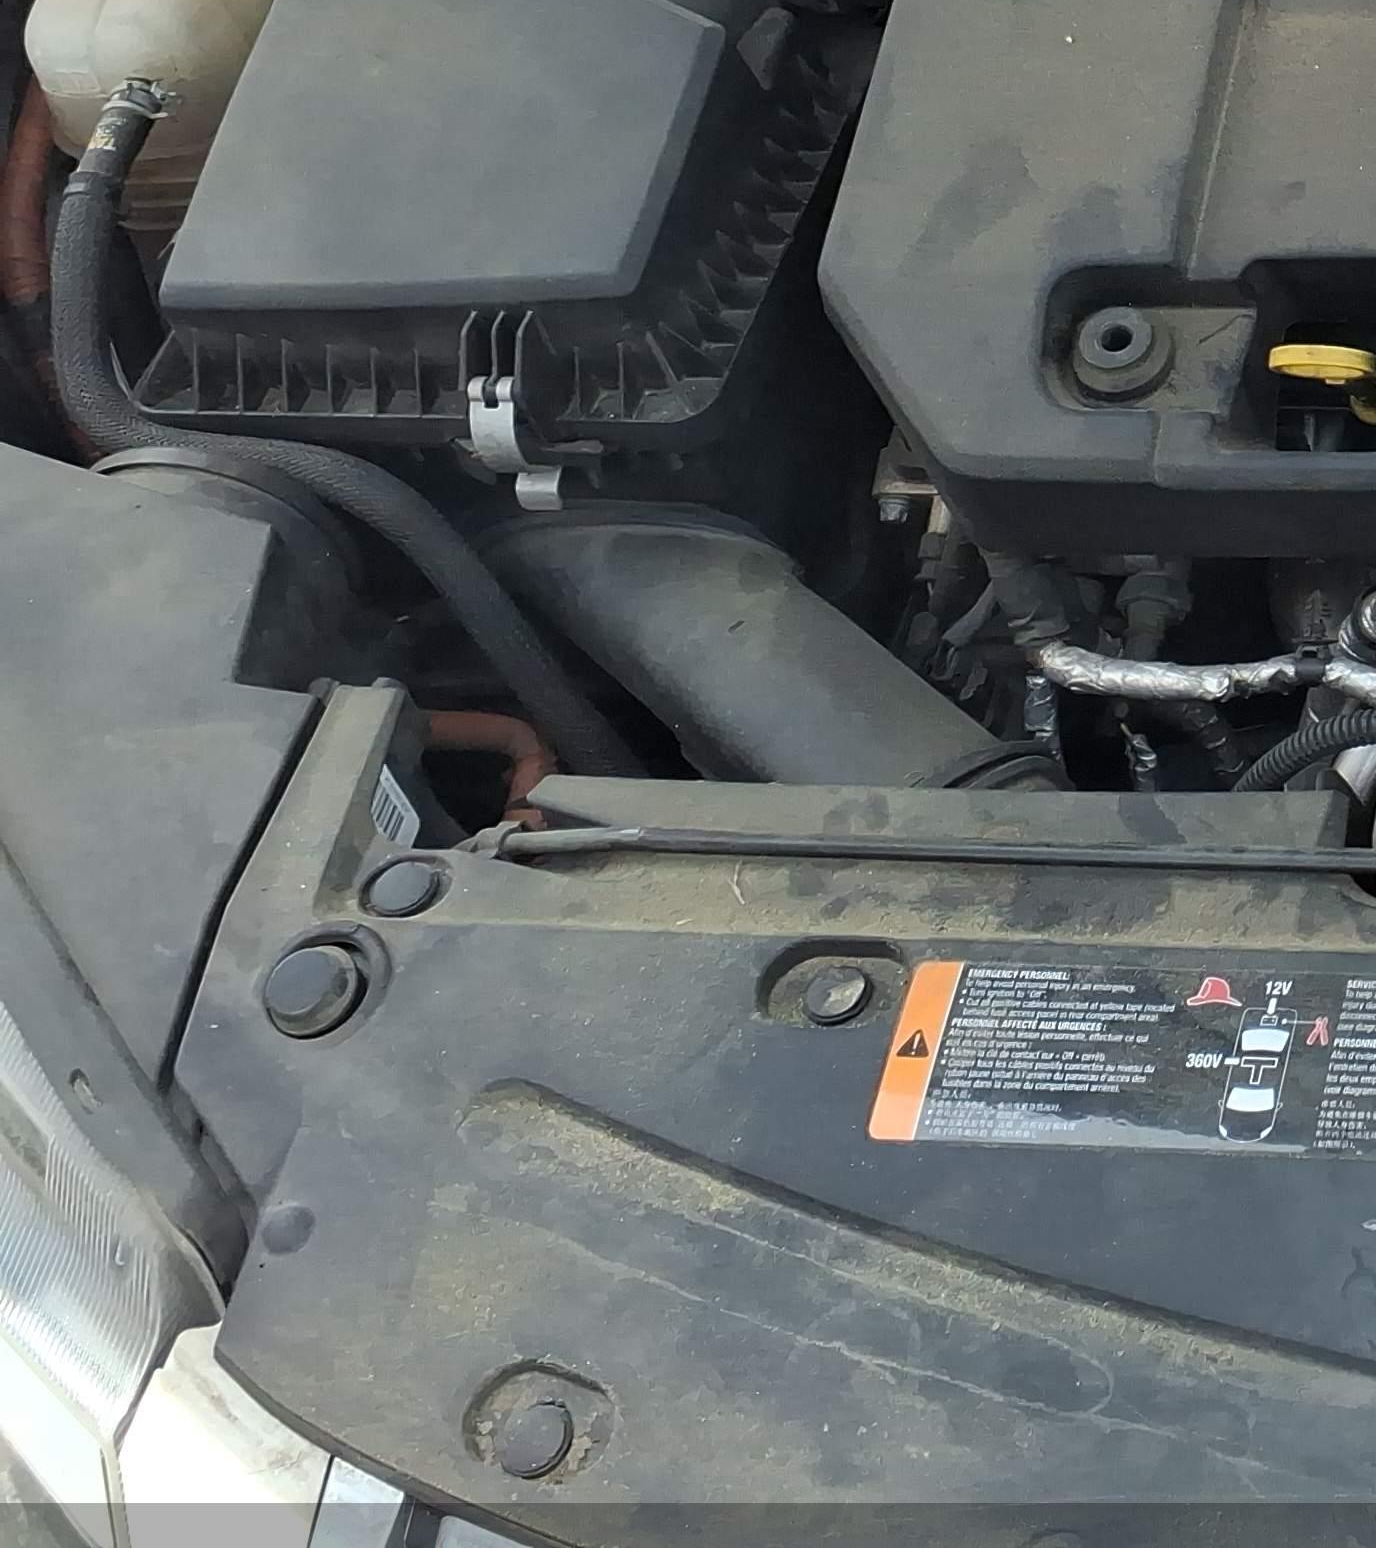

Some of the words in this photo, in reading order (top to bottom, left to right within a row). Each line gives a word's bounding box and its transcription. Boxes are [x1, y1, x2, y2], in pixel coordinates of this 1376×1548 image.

[969, 969, 1018, 978] EMERGENCY
[1265, 981, 1292, 995] 12V
[952, 1019, 998, 1028] PERSONNEL
[1039, 1022, 1056, 1030] AUX
[1058, 1022, 1100, 1031] URGENCES
[1186, 1053, 1222, 1068] 360V
